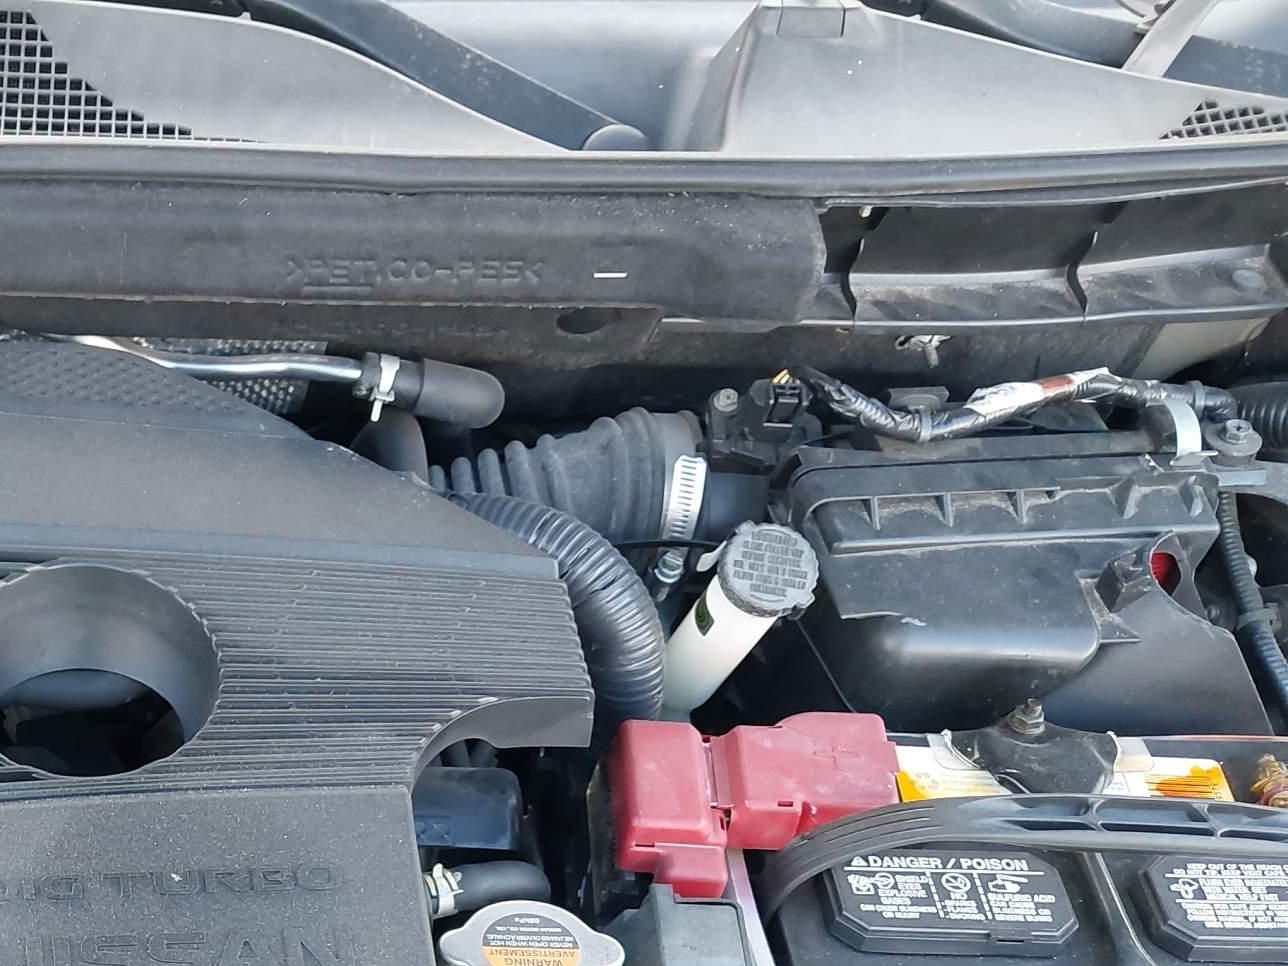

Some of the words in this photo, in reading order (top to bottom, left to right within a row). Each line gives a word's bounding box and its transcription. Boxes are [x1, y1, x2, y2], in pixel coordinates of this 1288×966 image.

[867, 855, 943, 869] DANGER
[945, 857, 957, 869] /
[959, 858, 1029, 871] POISON
[101, 863, 343, 898] TURBO
[878, 889, 928, 898] EXPLOSIVE
[950, 892, 967, 900] NO
[1033, 894, 1056, 904] ACID
[488, 948, 576, 958] AVERTISSEMENT
